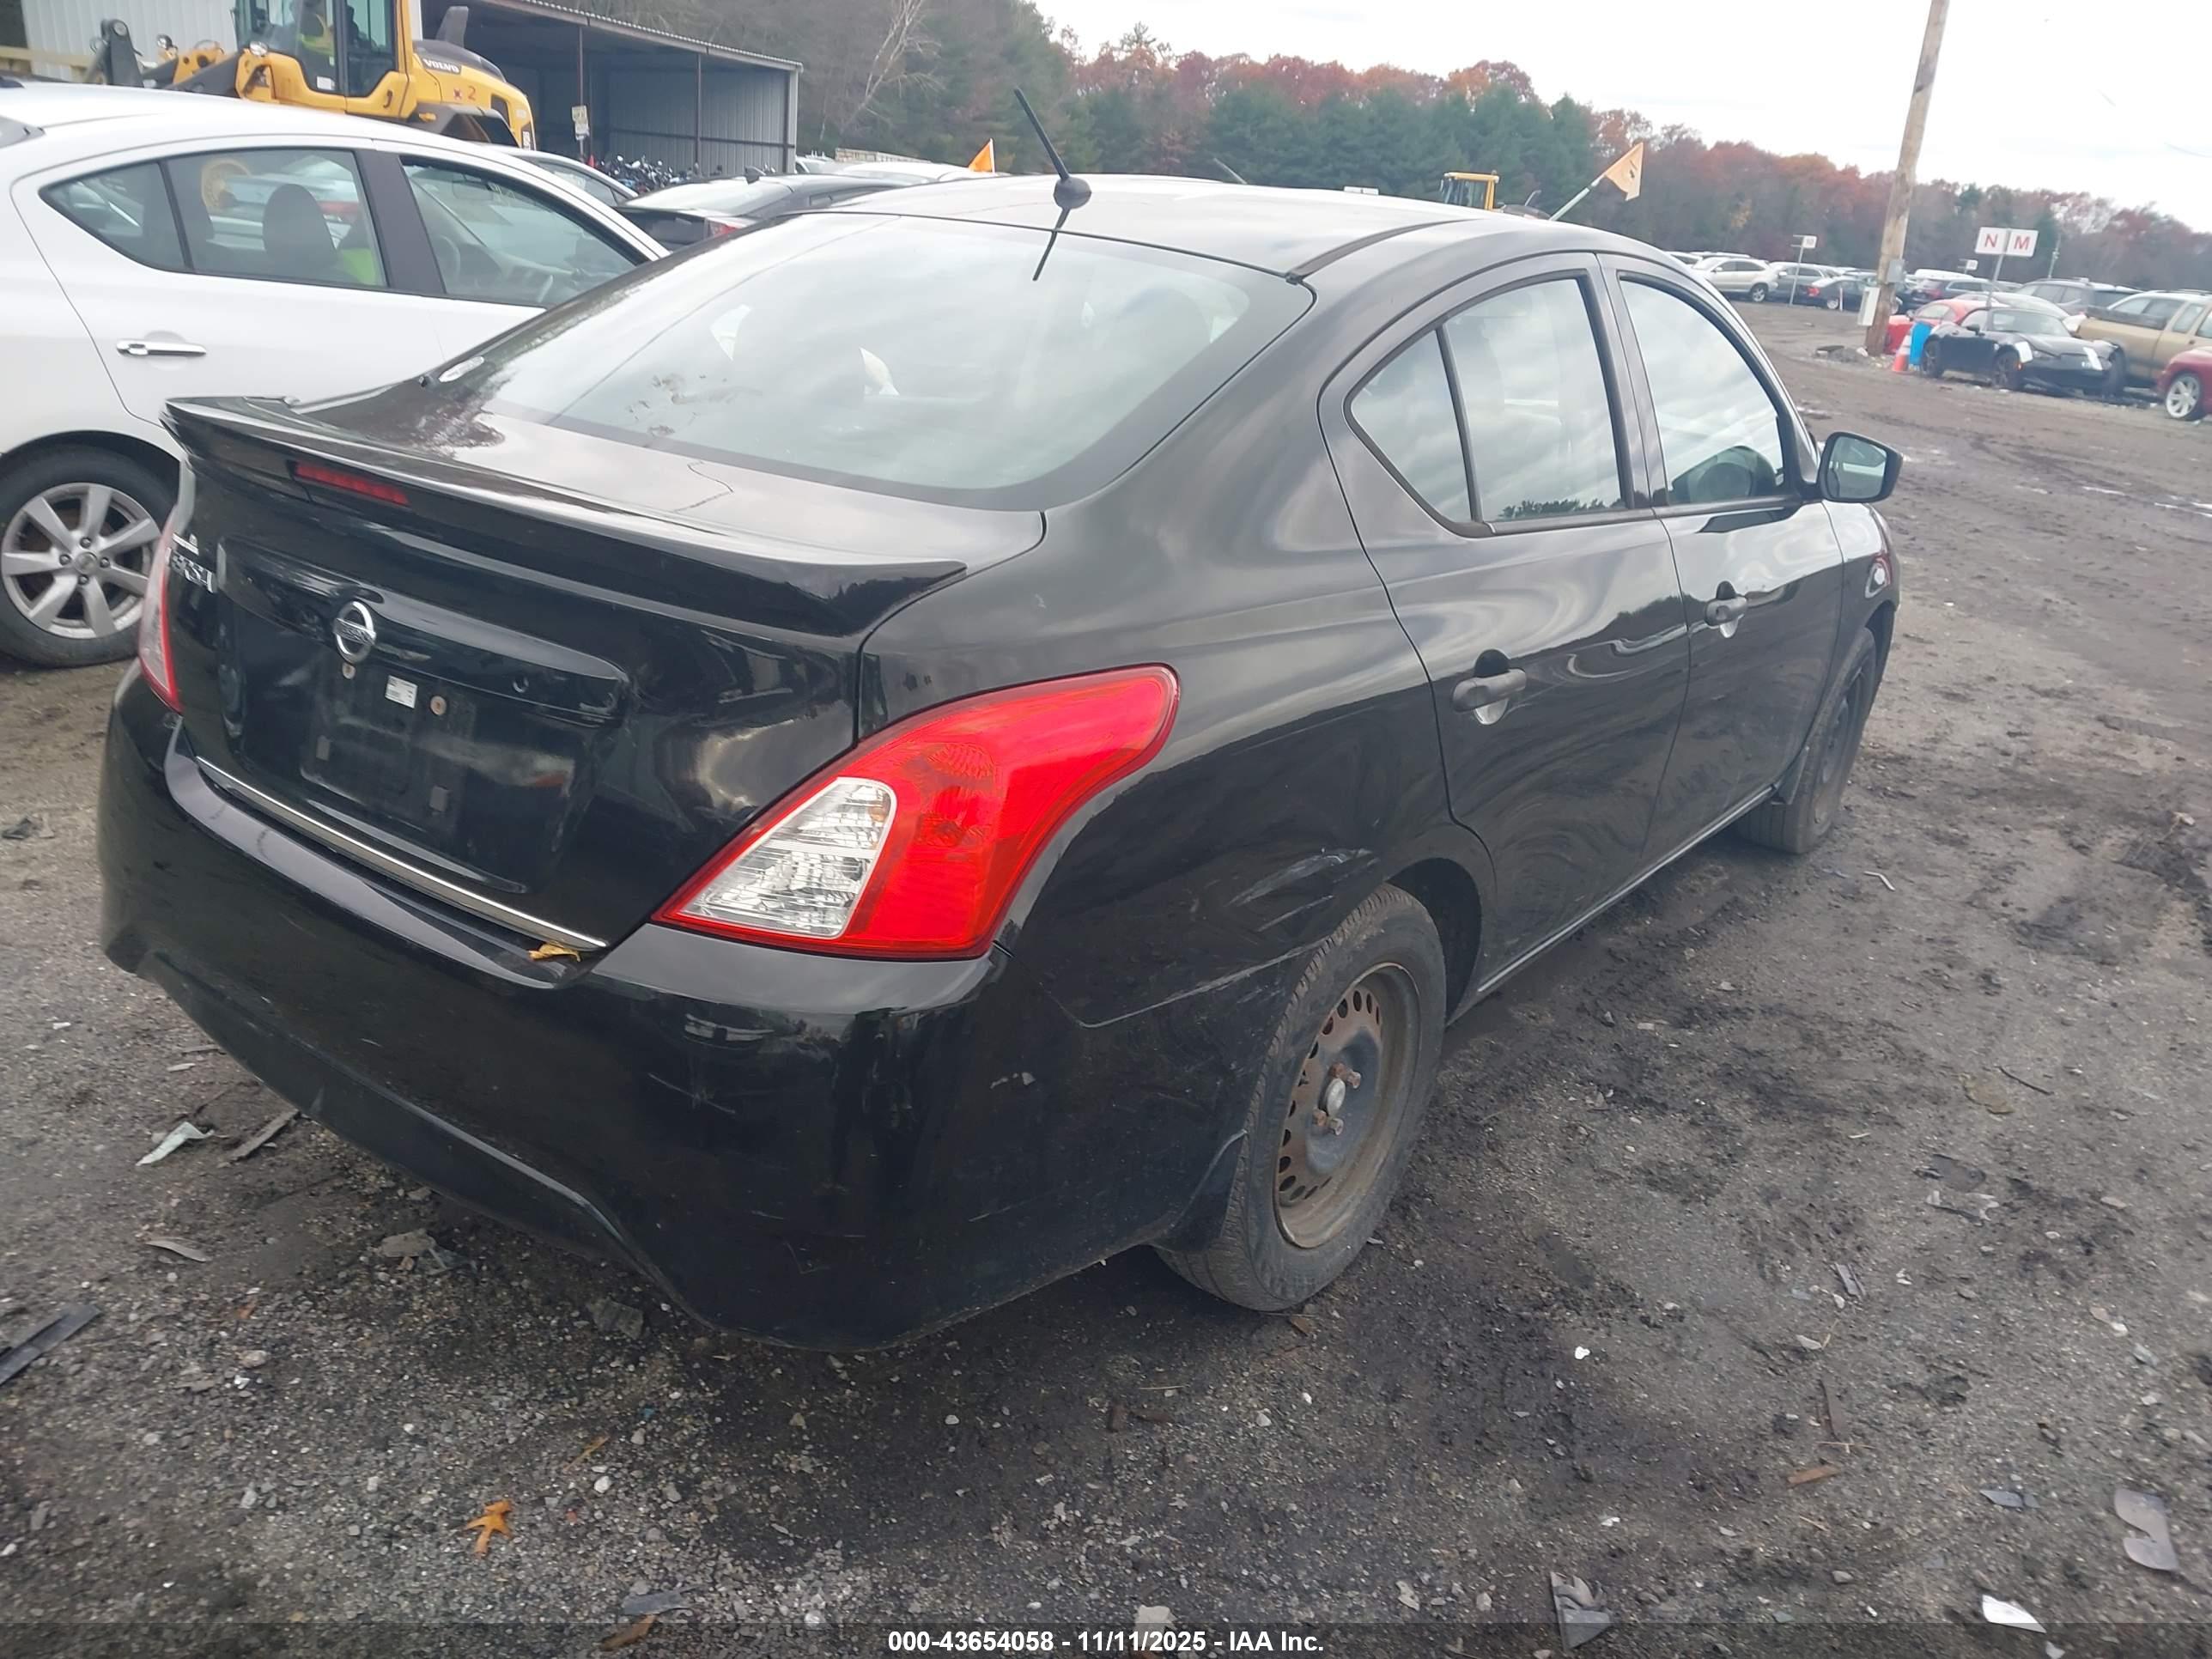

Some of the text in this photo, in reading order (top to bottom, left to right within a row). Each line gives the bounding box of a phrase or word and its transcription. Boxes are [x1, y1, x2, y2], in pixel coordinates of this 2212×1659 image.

[422, 58, 459, 73] VOLVO
[1984, 233, 1998, 247] N
[2014, 234, 2030, 250] M
